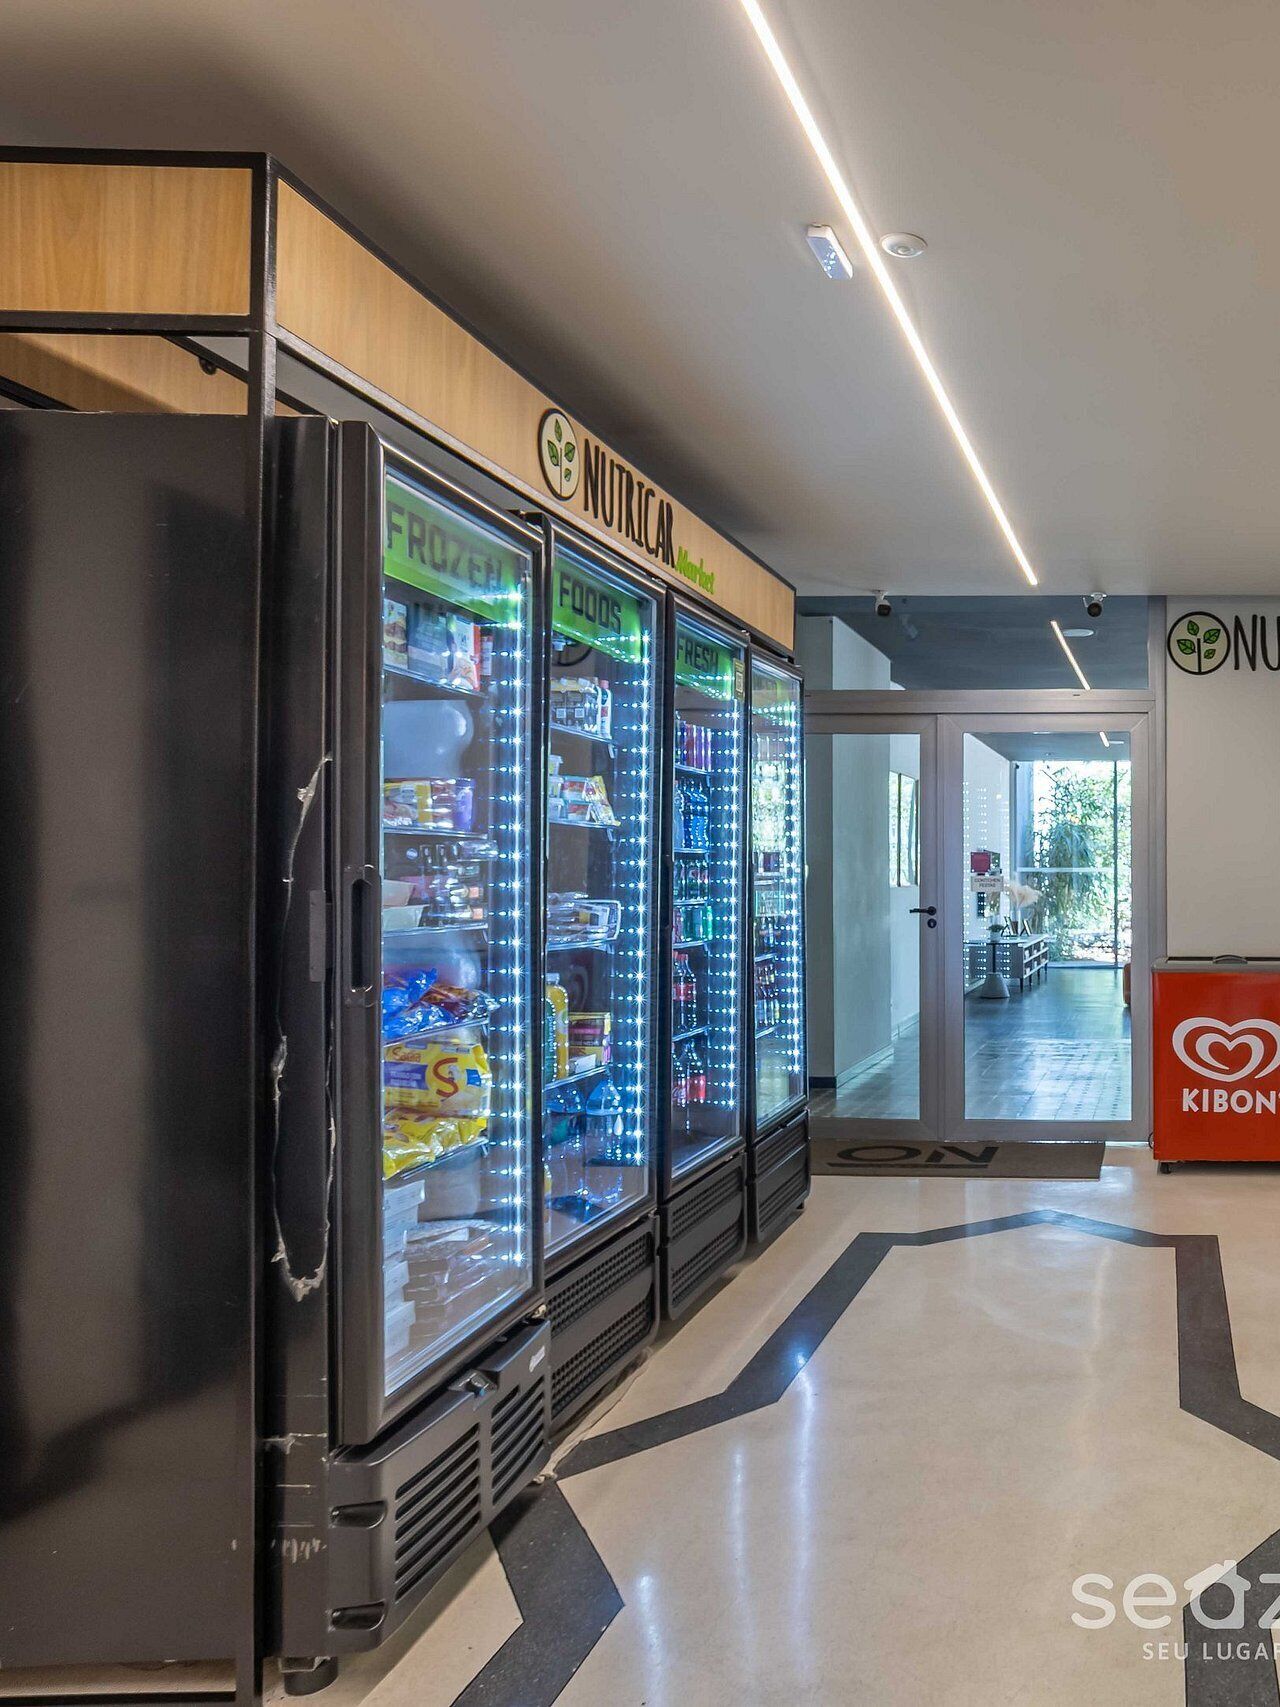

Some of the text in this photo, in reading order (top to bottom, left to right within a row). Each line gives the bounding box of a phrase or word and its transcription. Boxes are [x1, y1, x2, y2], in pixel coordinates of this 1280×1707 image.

[584, 438, 676, 569] NUTRICAR
[675, 545, 716, 596] Market
[559, 571, 623, 635] FOODS
[677, 638, 719, 675] FRESH
[1182, 1087, 1277, 1115] KIBON
